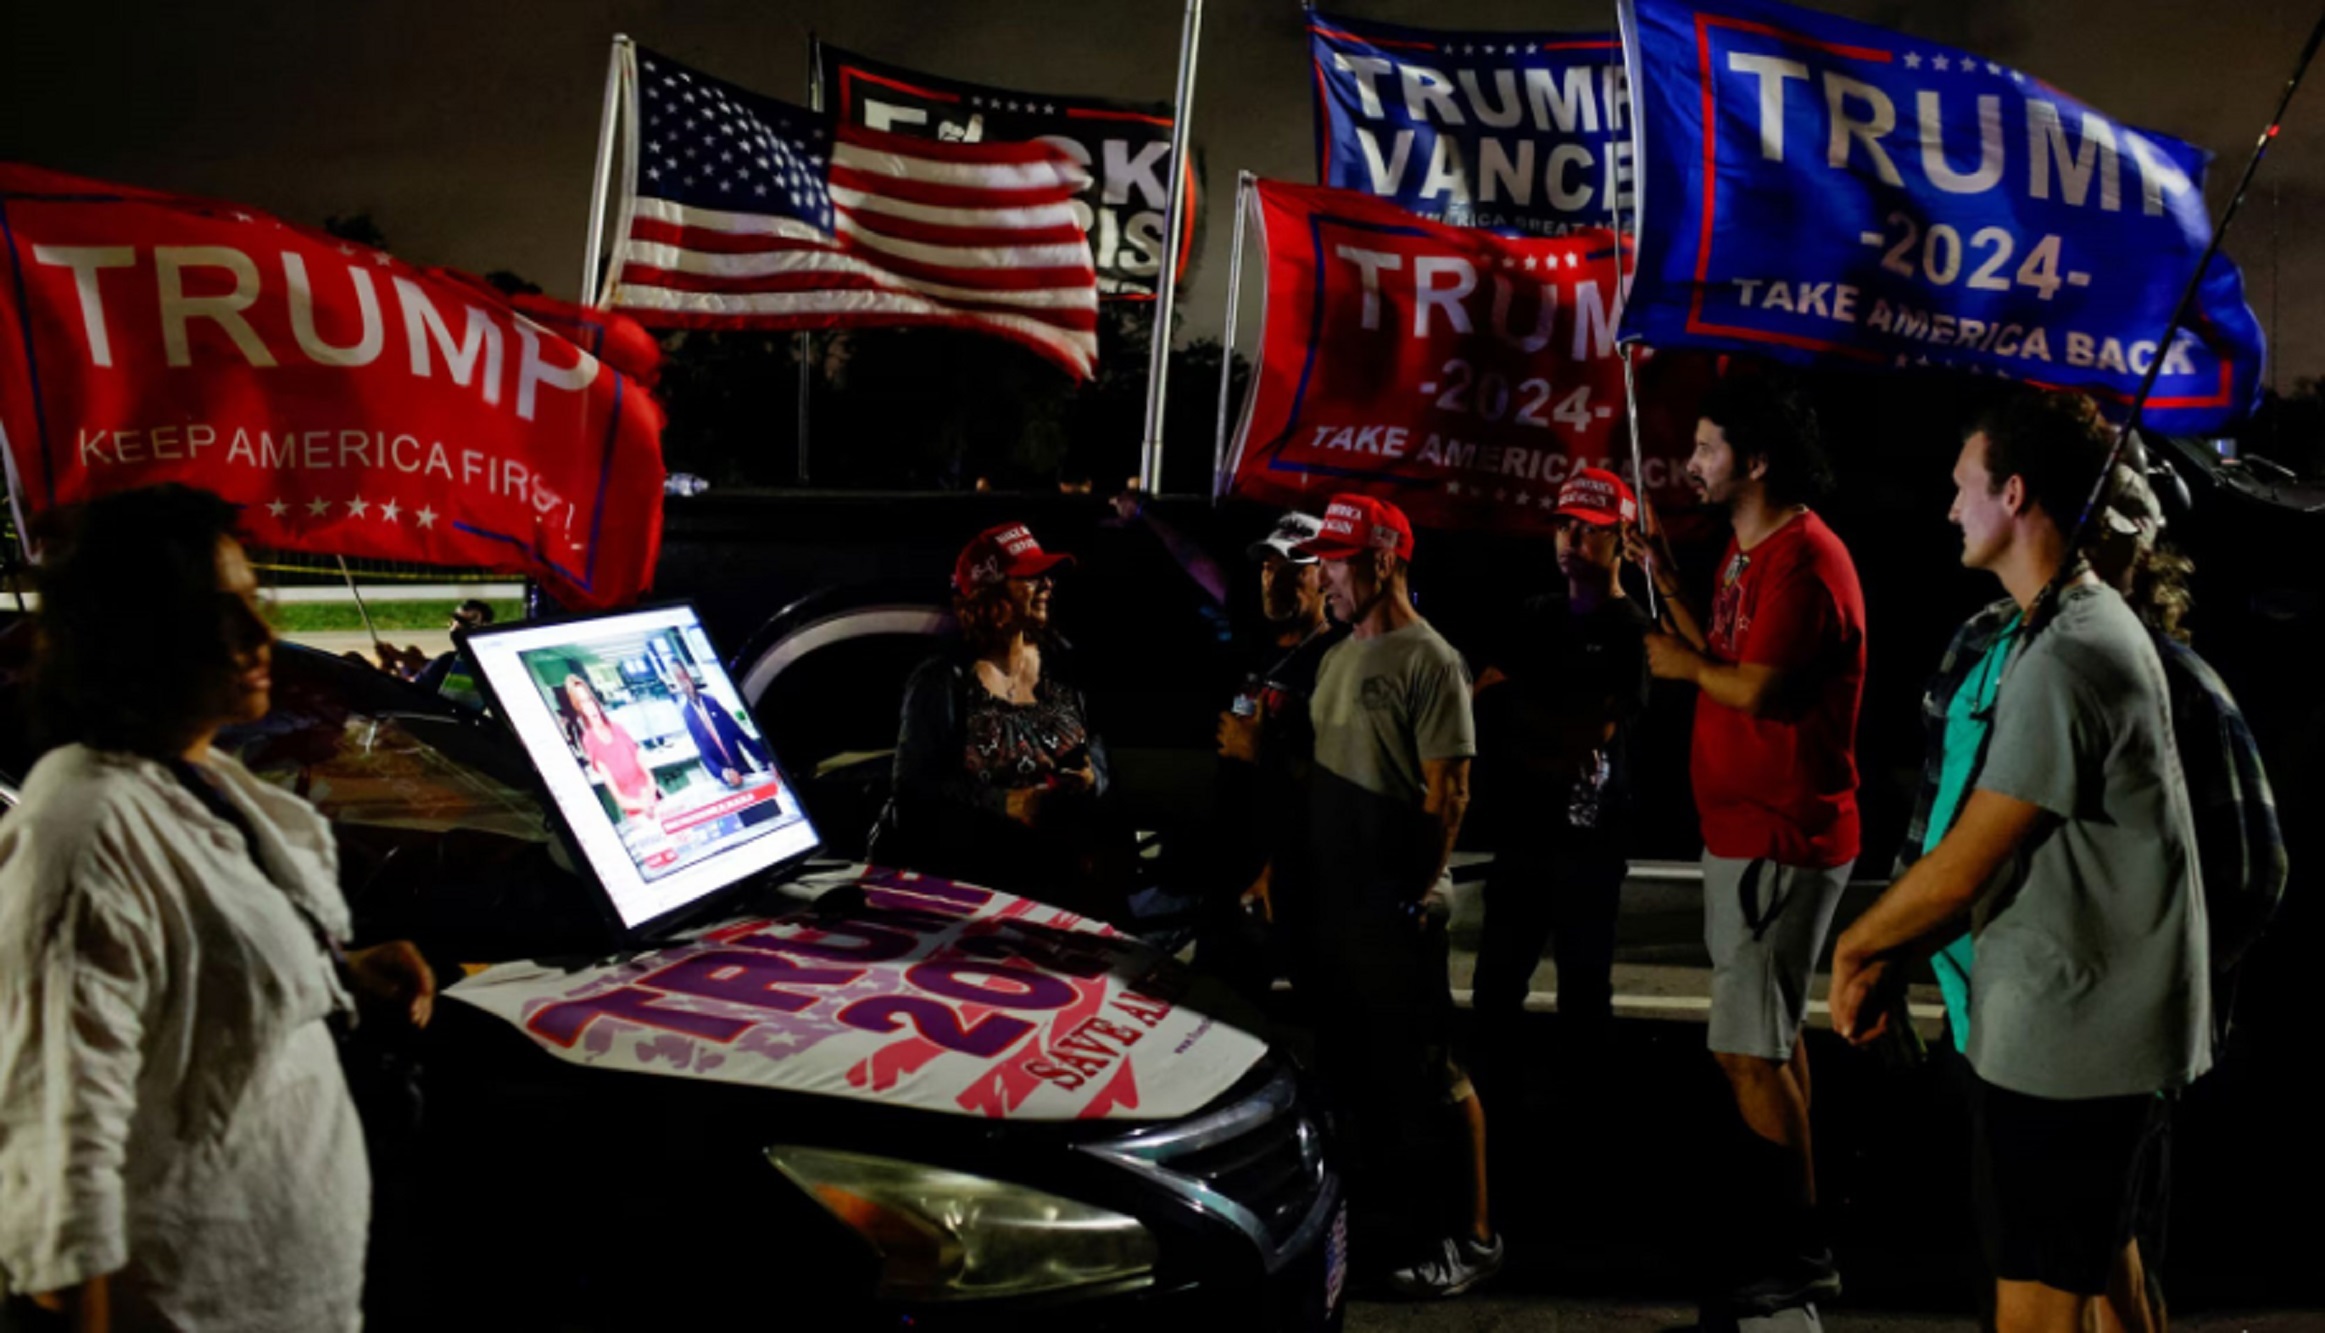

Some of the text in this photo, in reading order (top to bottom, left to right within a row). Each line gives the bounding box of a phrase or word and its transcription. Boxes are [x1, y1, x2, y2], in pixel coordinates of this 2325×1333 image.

[1356, 128, 1635, 211] VANCE
[33, 242, 600, 421] TRUMP
[1731, 279, 2197, 376] TAKE AMERICA BACK
[79, 424, 217, 467] KEEP
[226, 426, 453, 480] AMERICA
[1310, 424, 1409, 459] TAKE
[1025, 1014, 1144, 1092] SAVE
